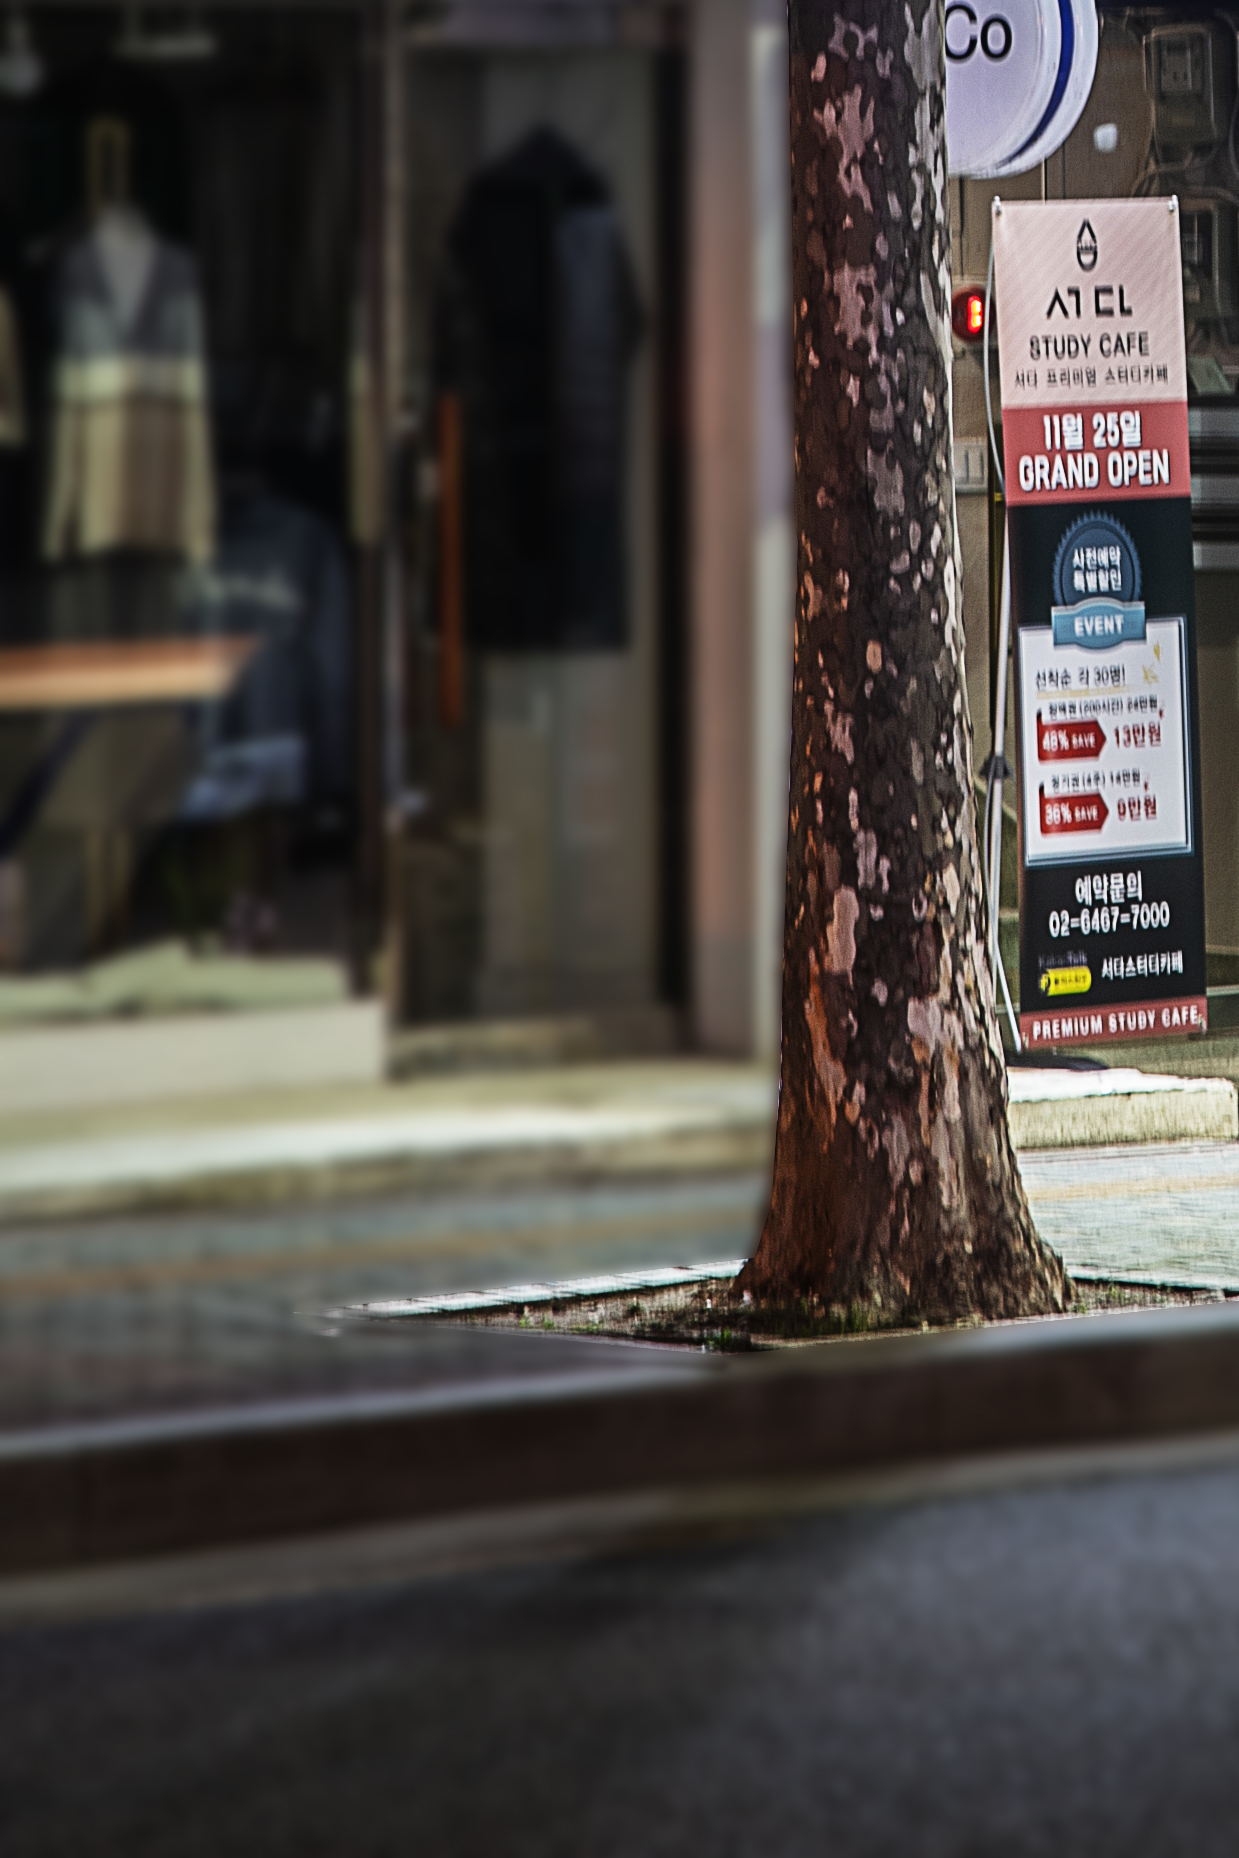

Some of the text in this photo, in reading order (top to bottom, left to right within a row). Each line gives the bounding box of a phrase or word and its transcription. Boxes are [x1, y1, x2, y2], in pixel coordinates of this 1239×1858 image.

[1030, 331, 1150, 360] STUDY CAFE
[1014, 362, 1169, 391] 서다 프리미엄 스터디카페
[1043, 410, 1142, 451] 11월 25일
[1019, 448, 1170, 492] GRAND OPEN
[1072, 545, 1122, 572] 사전예약
[1074, 614, 1124, 637] EVENT
[1071, 732, 1097, 749] SAVE
[1074, 805, 1099, 822] SAVE
[1075, 870, 1143, 906] 예약문의
[1049, 900, 1170, 938] 02-6467-7000
[1101, 949, 1184, 981] 서다스터디카페
[1032, 1004, 1199, 1042] PREMIUM STUDY CAFE
